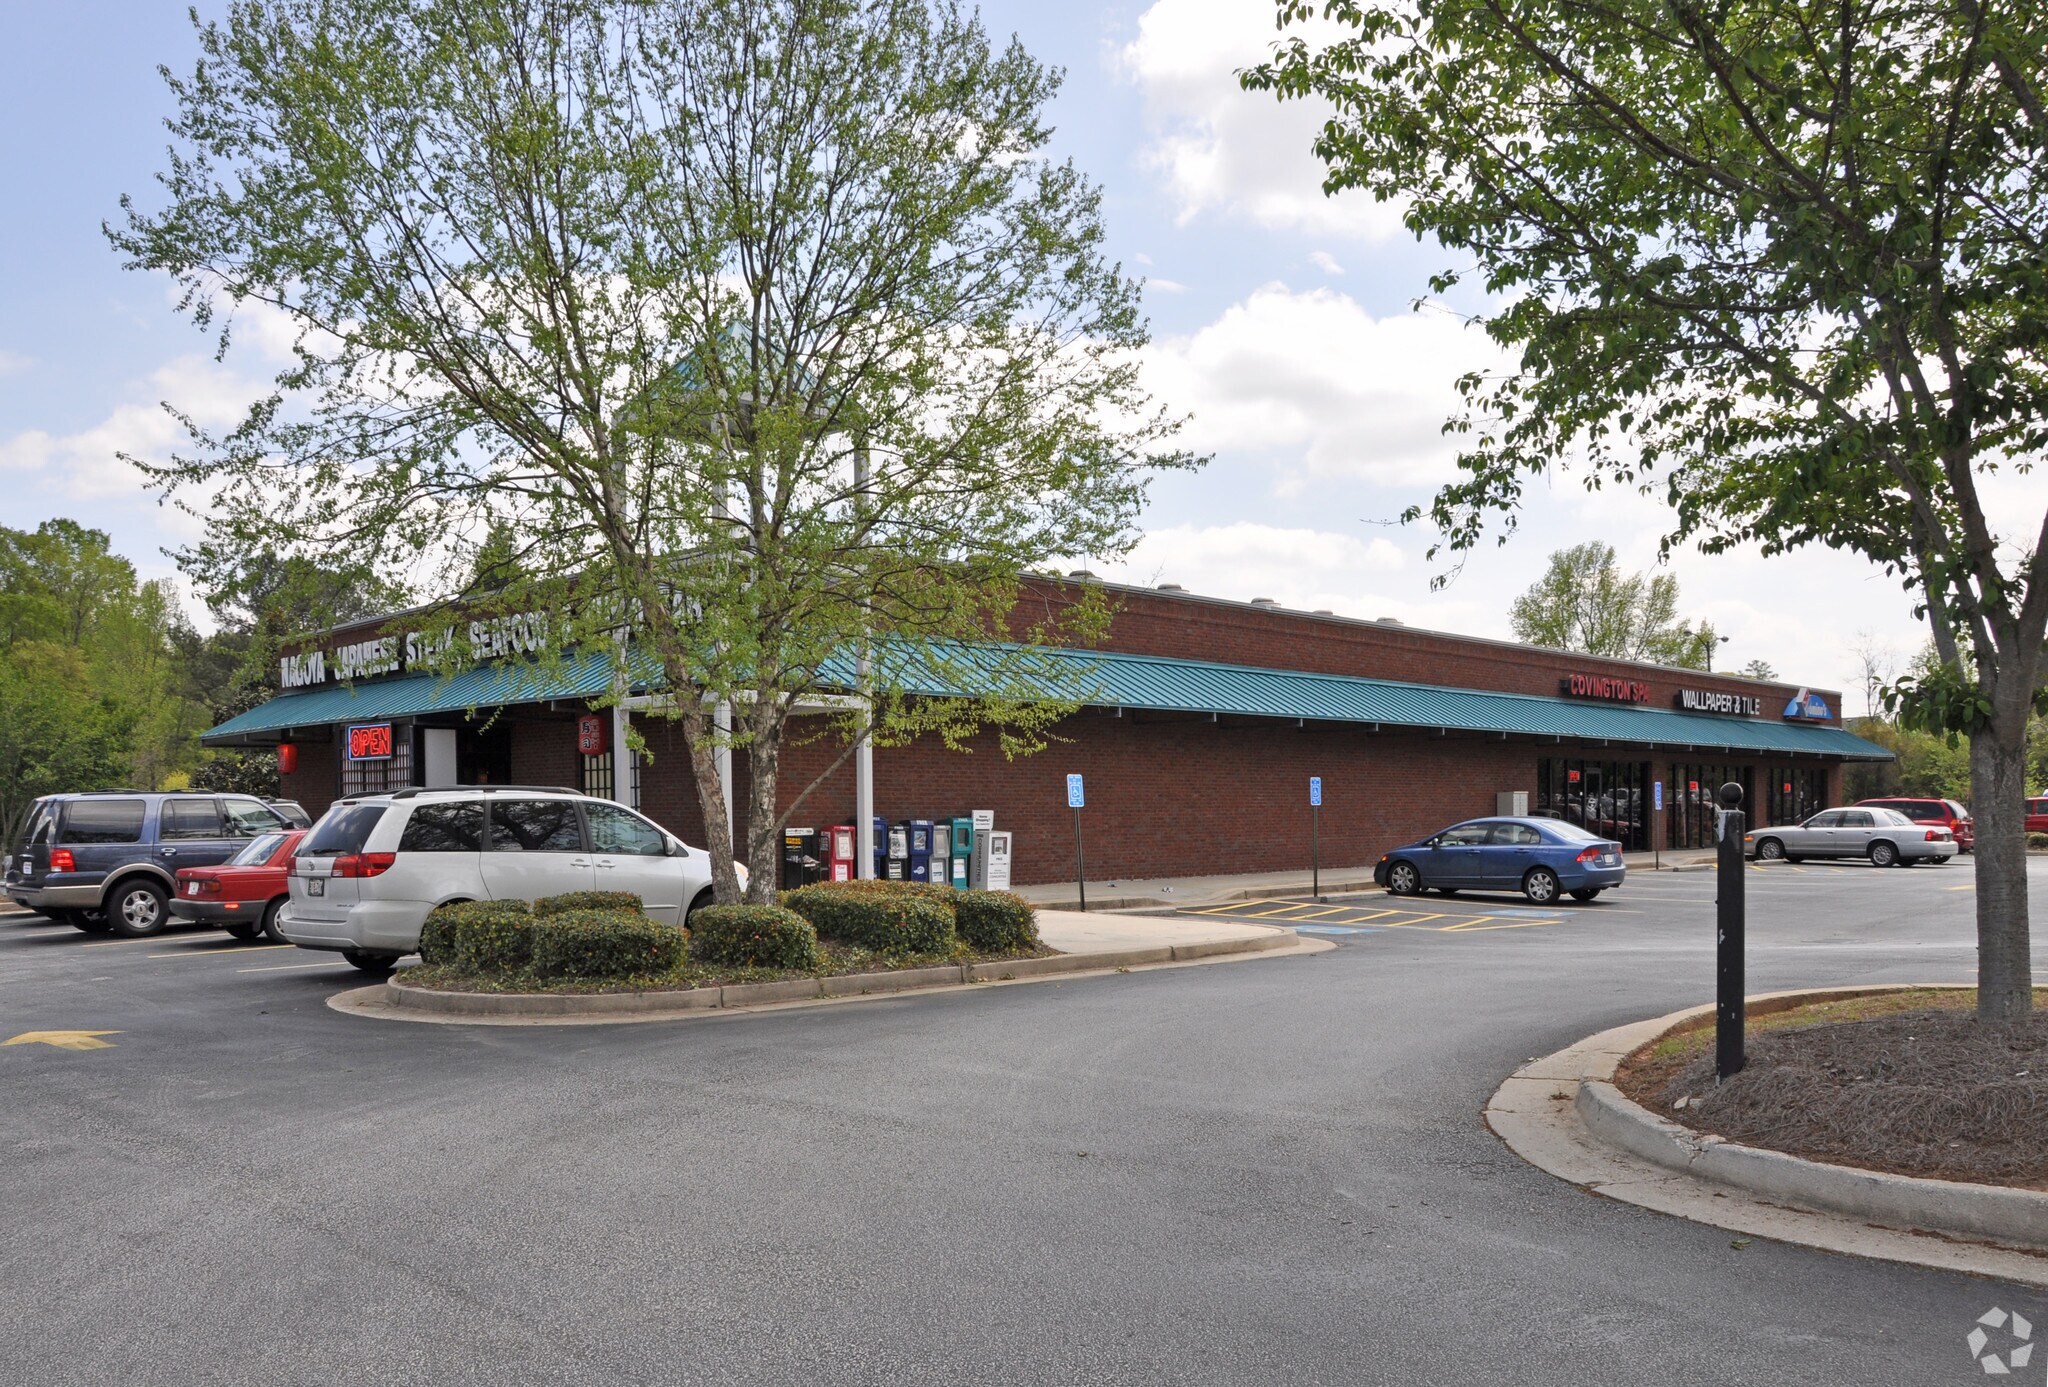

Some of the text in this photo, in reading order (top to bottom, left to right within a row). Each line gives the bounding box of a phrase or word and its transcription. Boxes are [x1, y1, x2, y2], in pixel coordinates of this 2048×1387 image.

[281, 651, 325, 688] NAGOYA
[1571, 674, 1649, 703] COVINGTON SPA
[1682, 689, 1760, 715] WALLPAPER & TILE
[350, 726, 391, 757] OPEN
